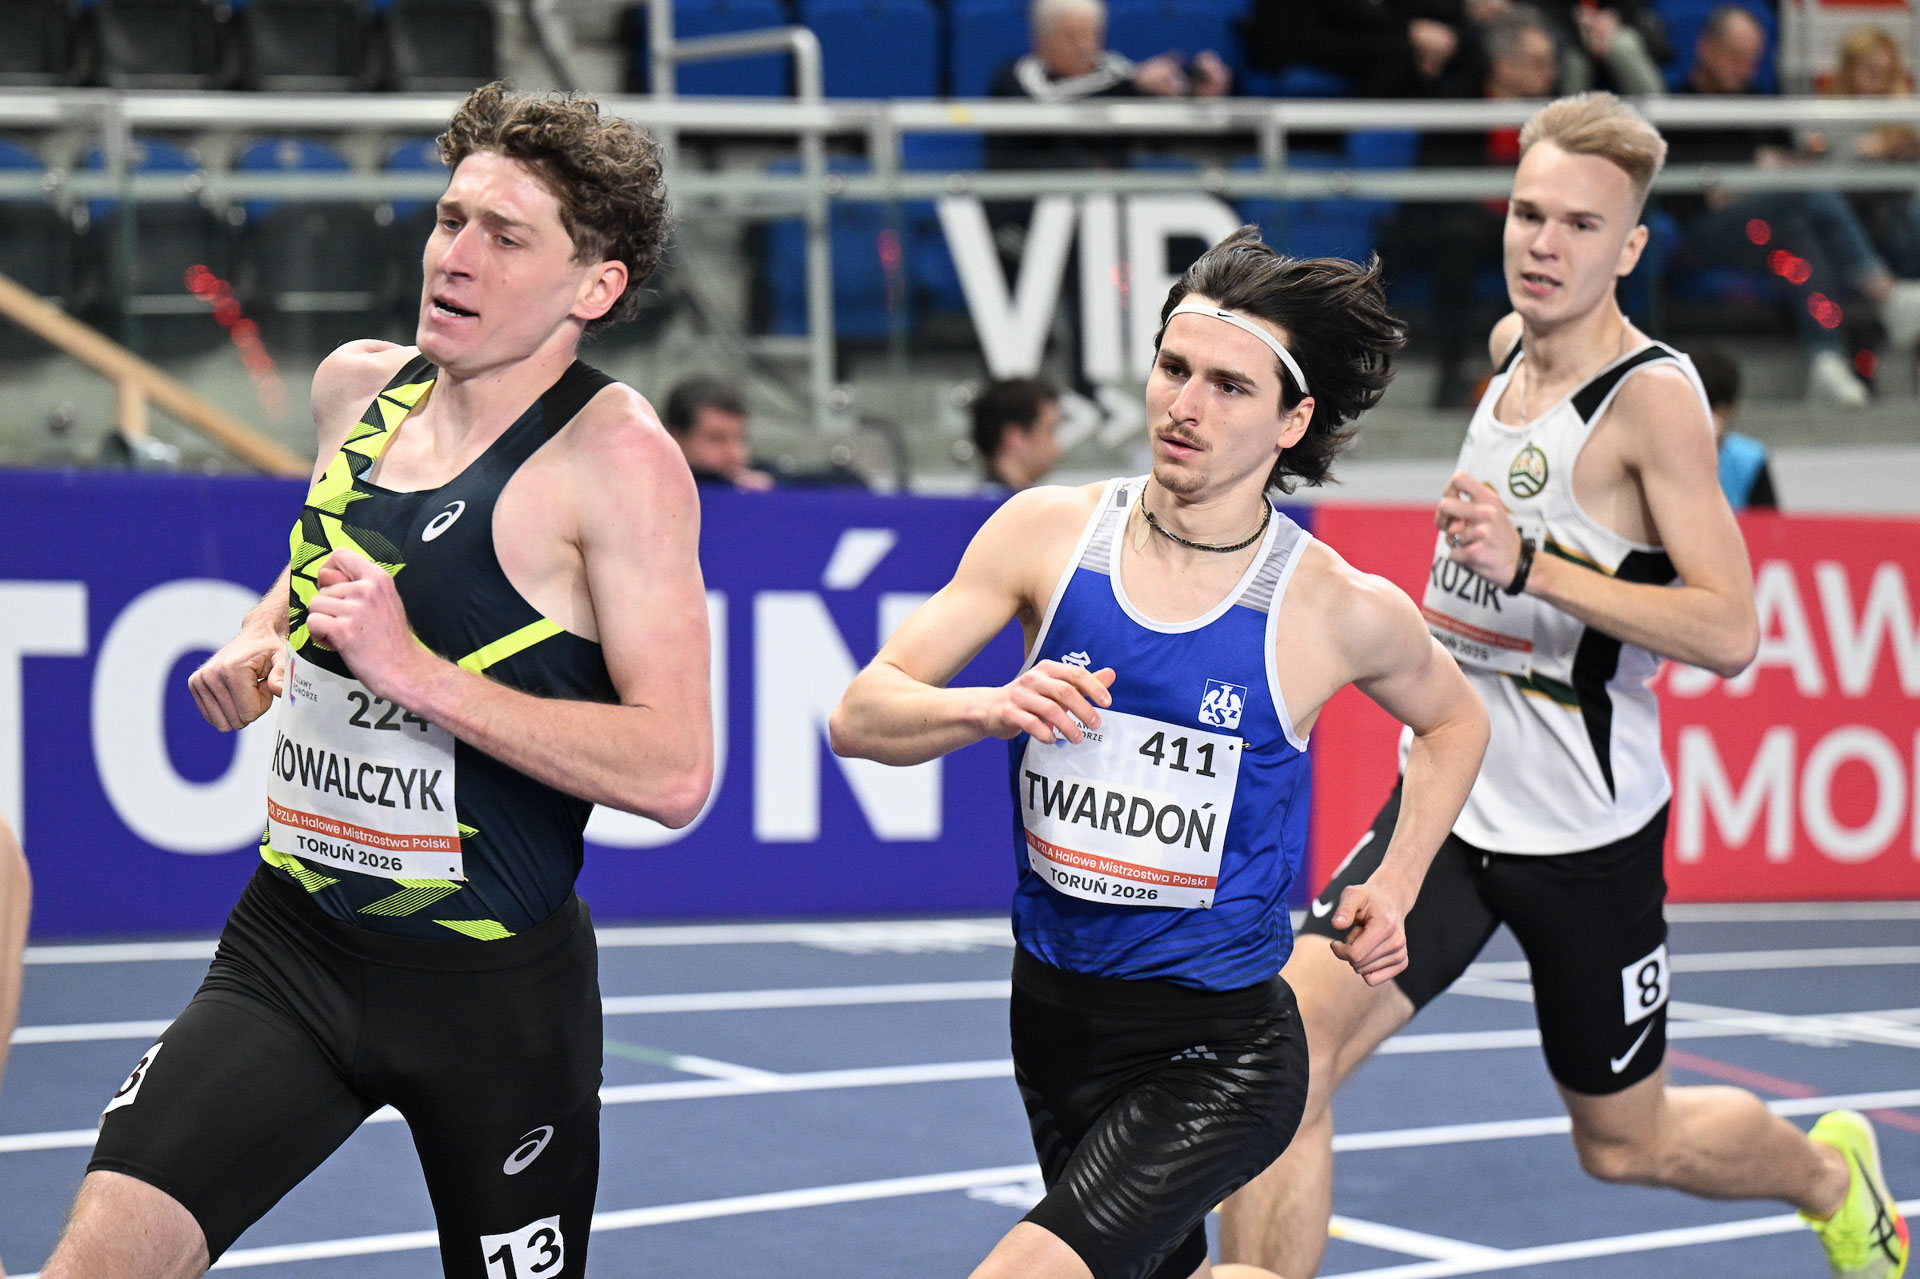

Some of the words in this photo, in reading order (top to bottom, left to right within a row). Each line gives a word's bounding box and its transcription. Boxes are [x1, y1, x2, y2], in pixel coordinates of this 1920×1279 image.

[934, 193, 1246, 384] VIP
[347, 690, 433, 732] 224
[272, 730, 444, 812] KOWALCZYK
[1139, 731, 1216, 778] 411
[1025, 770, 1216, 852] TWARDOŃ
[1676, 724, 1920, 864] MO
[276, 809, 299, 824] PZLA
[301, 815, 341, 834] Halowe
[343, 825, 409, 848] Mistrzostwa
[412, 837, 450, 849] Polski
[297, 835, 354, 862] TORUŃ
[358, 851, 402, 871] 2026
[1037, 842, 1053, 858] PZLA
[1055, 850, 1096, 868] Halowe
[1099, 859, 1170, 883] Mistrzostwa
[1172, 874, 1207, 887] Polski
[1050, 867, 1108, 895] TORUŃ
[1112, 884, 1158, 900] 2026
[1637, 961, 1660, 1008] 8
[488, 1227, 561, 1279] 13
